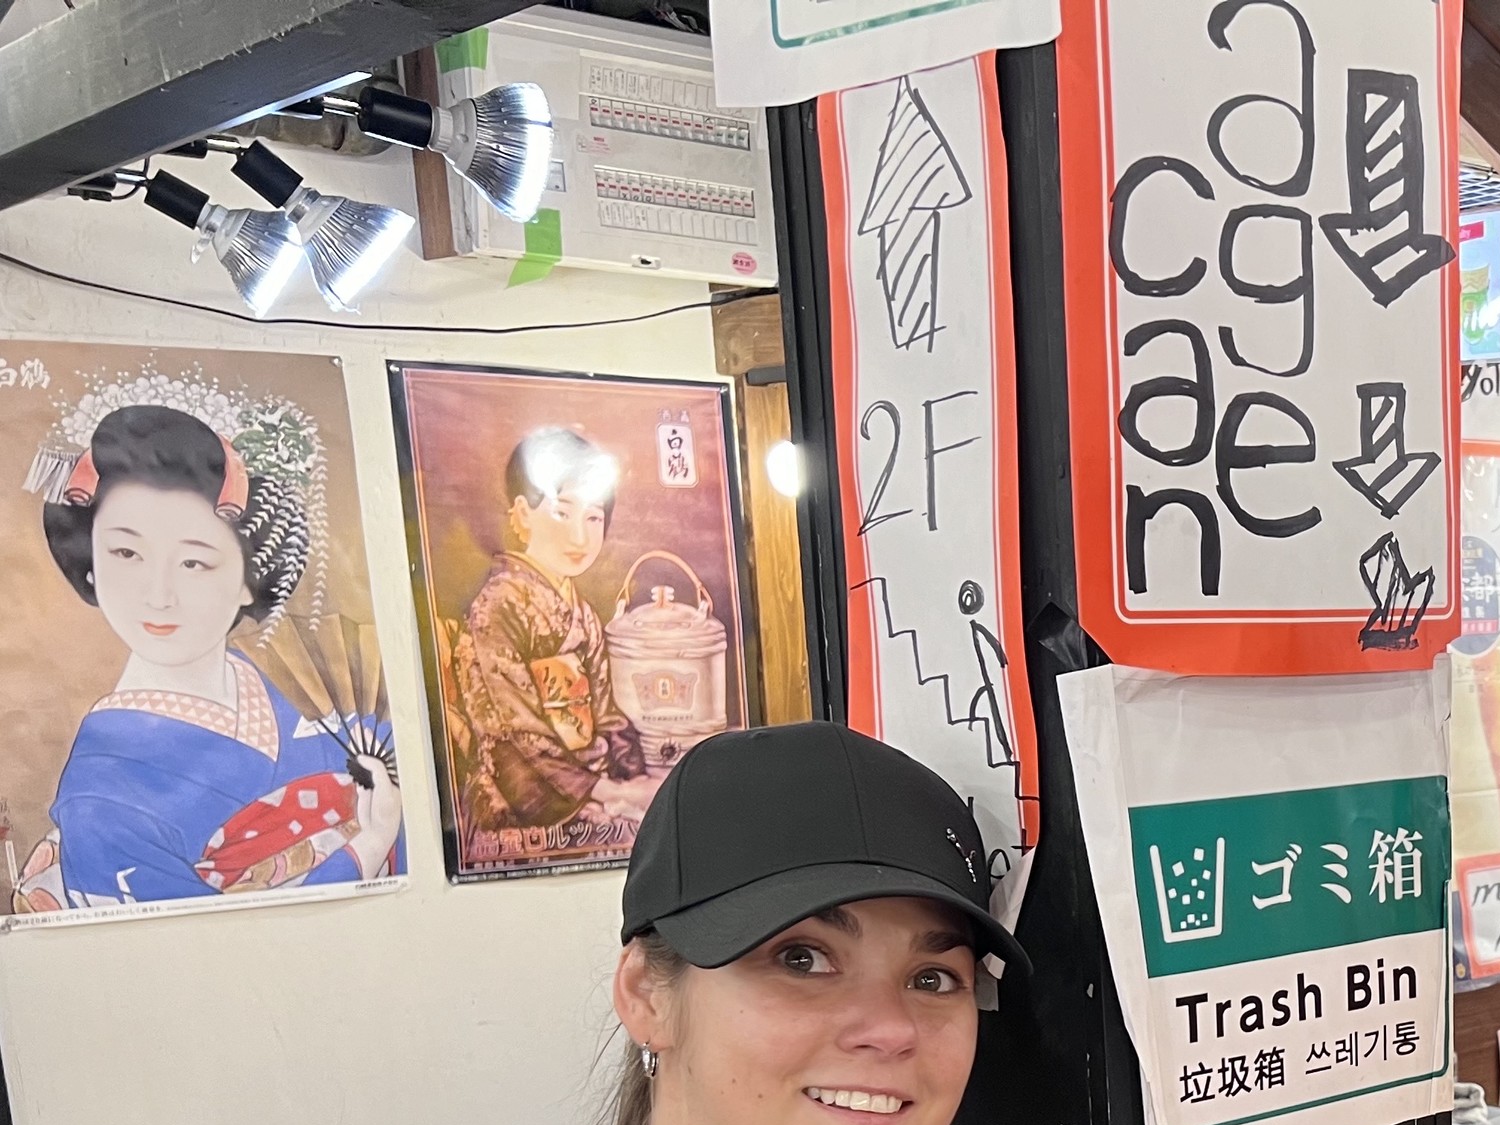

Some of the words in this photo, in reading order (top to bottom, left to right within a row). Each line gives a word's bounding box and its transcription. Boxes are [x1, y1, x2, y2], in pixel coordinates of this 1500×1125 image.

[857, 390, 981, 536] 2F
[1251, 827, 1424, 911] ゴミ箱
[1175, 972, 1323, 1044] Trash
[1346, 957, 1418, 1012] Bin
[1179, 1046, 1286, 1104] 垃圾箱
[1304, 1020, 1421, 1075] 쓰레기통
